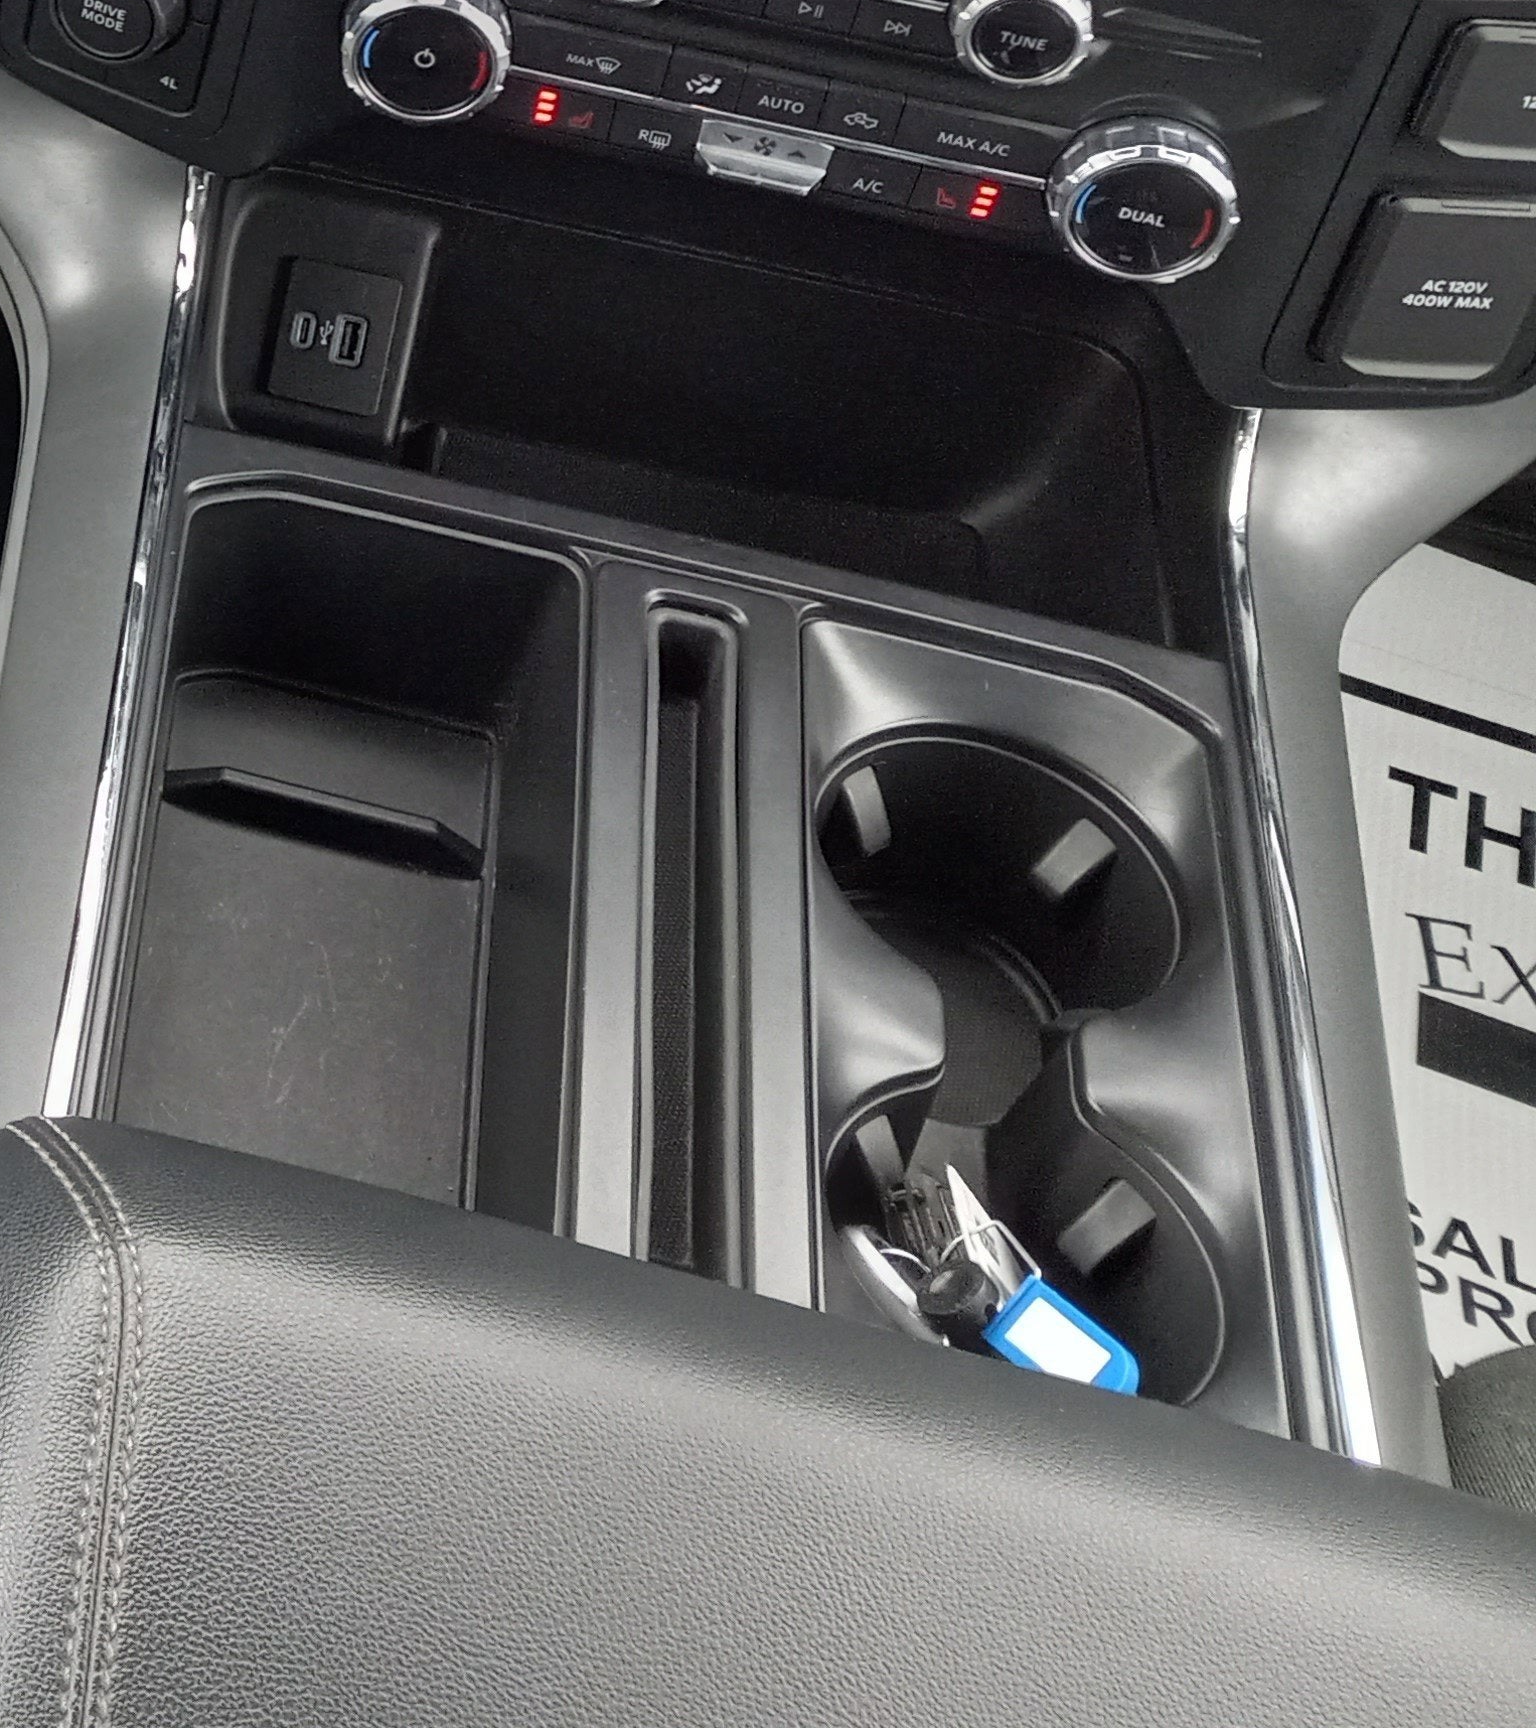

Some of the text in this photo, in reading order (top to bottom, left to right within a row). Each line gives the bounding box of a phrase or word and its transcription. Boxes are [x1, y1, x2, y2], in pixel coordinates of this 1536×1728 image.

[80, 8, 125, 33] MODE
[1000, 29, 1049, 52] TUNE
[566, 52, 596, 69] MAX
[159, 74, 179, 91] 4L
[757, 94, 806, 115] AUTO
[638, 129, 650, 143] R
[936, 130, 1011, 158] MAX A/C
[852, 176, 885, 195] A/C
[1118, 206, 1165, 228] DUAL
[1421, 279, 1488, 294] AC 120V
[1402, 293, 1494, 310] 400W MAX
